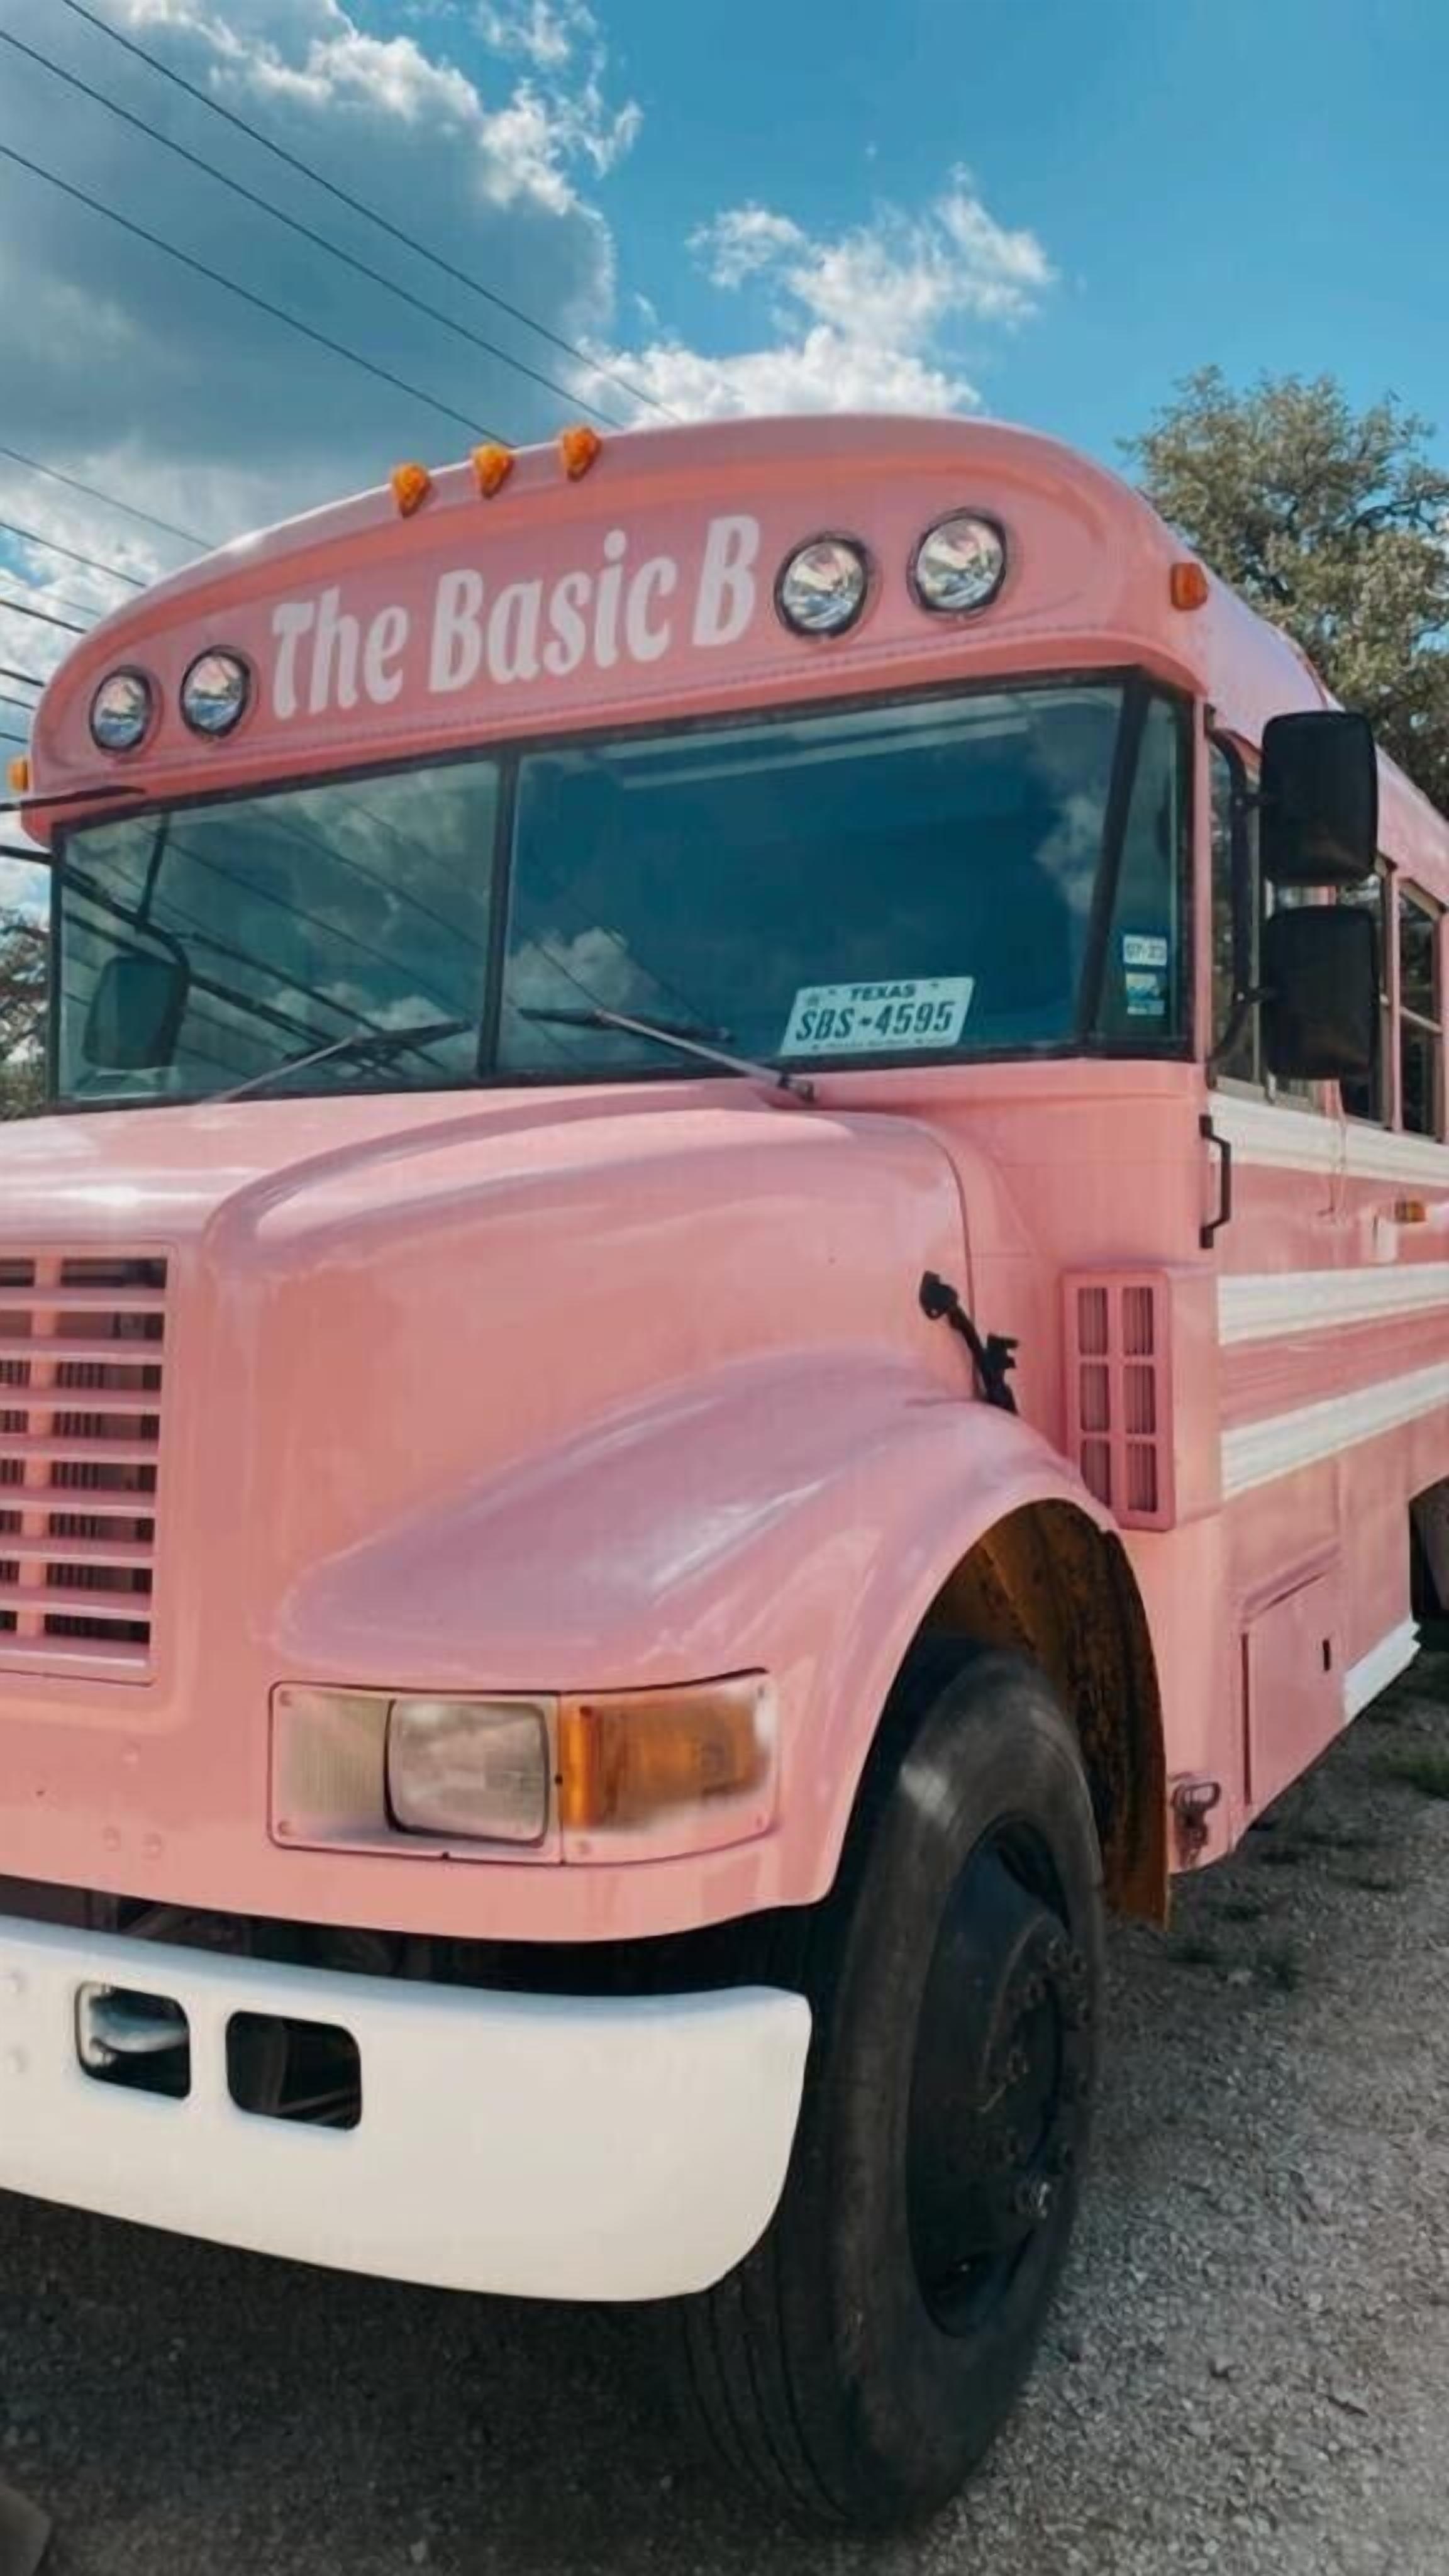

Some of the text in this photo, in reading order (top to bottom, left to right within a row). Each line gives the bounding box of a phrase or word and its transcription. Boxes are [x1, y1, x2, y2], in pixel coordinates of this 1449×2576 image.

[271, 514, 760, 721] The Basic B
[850, 983, 916, 1002] TEXAS
